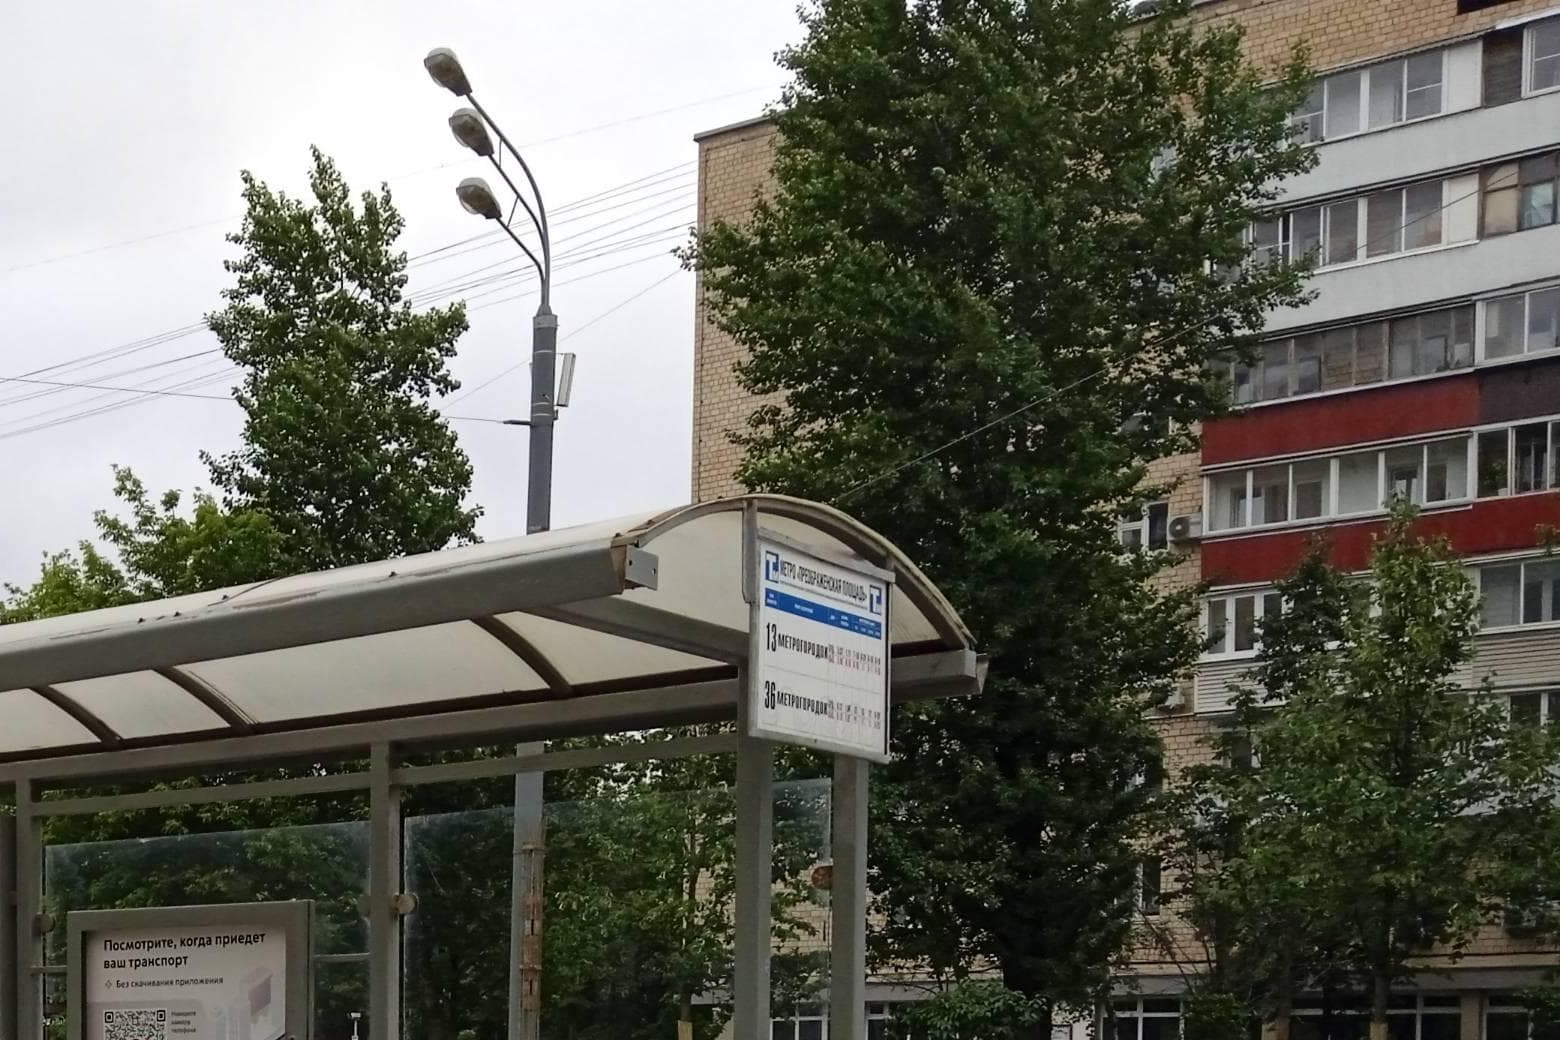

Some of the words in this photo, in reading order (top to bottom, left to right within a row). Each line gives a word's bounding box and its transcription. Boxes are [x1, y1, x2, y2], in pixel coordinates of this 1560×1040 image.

[766, 622, 777, 652] 13
[778, 633, 828, 660] МЕТРОГОРОДОК
[764, 680, 776, 710] 36
[776, 690, 828, 716] МЕТРОГОРОДОК
[103, 938, 177, 952] Посмотрите,
[180, 935, 213, 948] когда
[215, 932, 266, 948] приедет
[103, 959, 126, 969] ваш
[128, 955, 189, 970] транспорт
[116, 979, 130, 989] Без
[131, 978, 174, 988] скачивания
[175, 976, 224, 987] приложения
